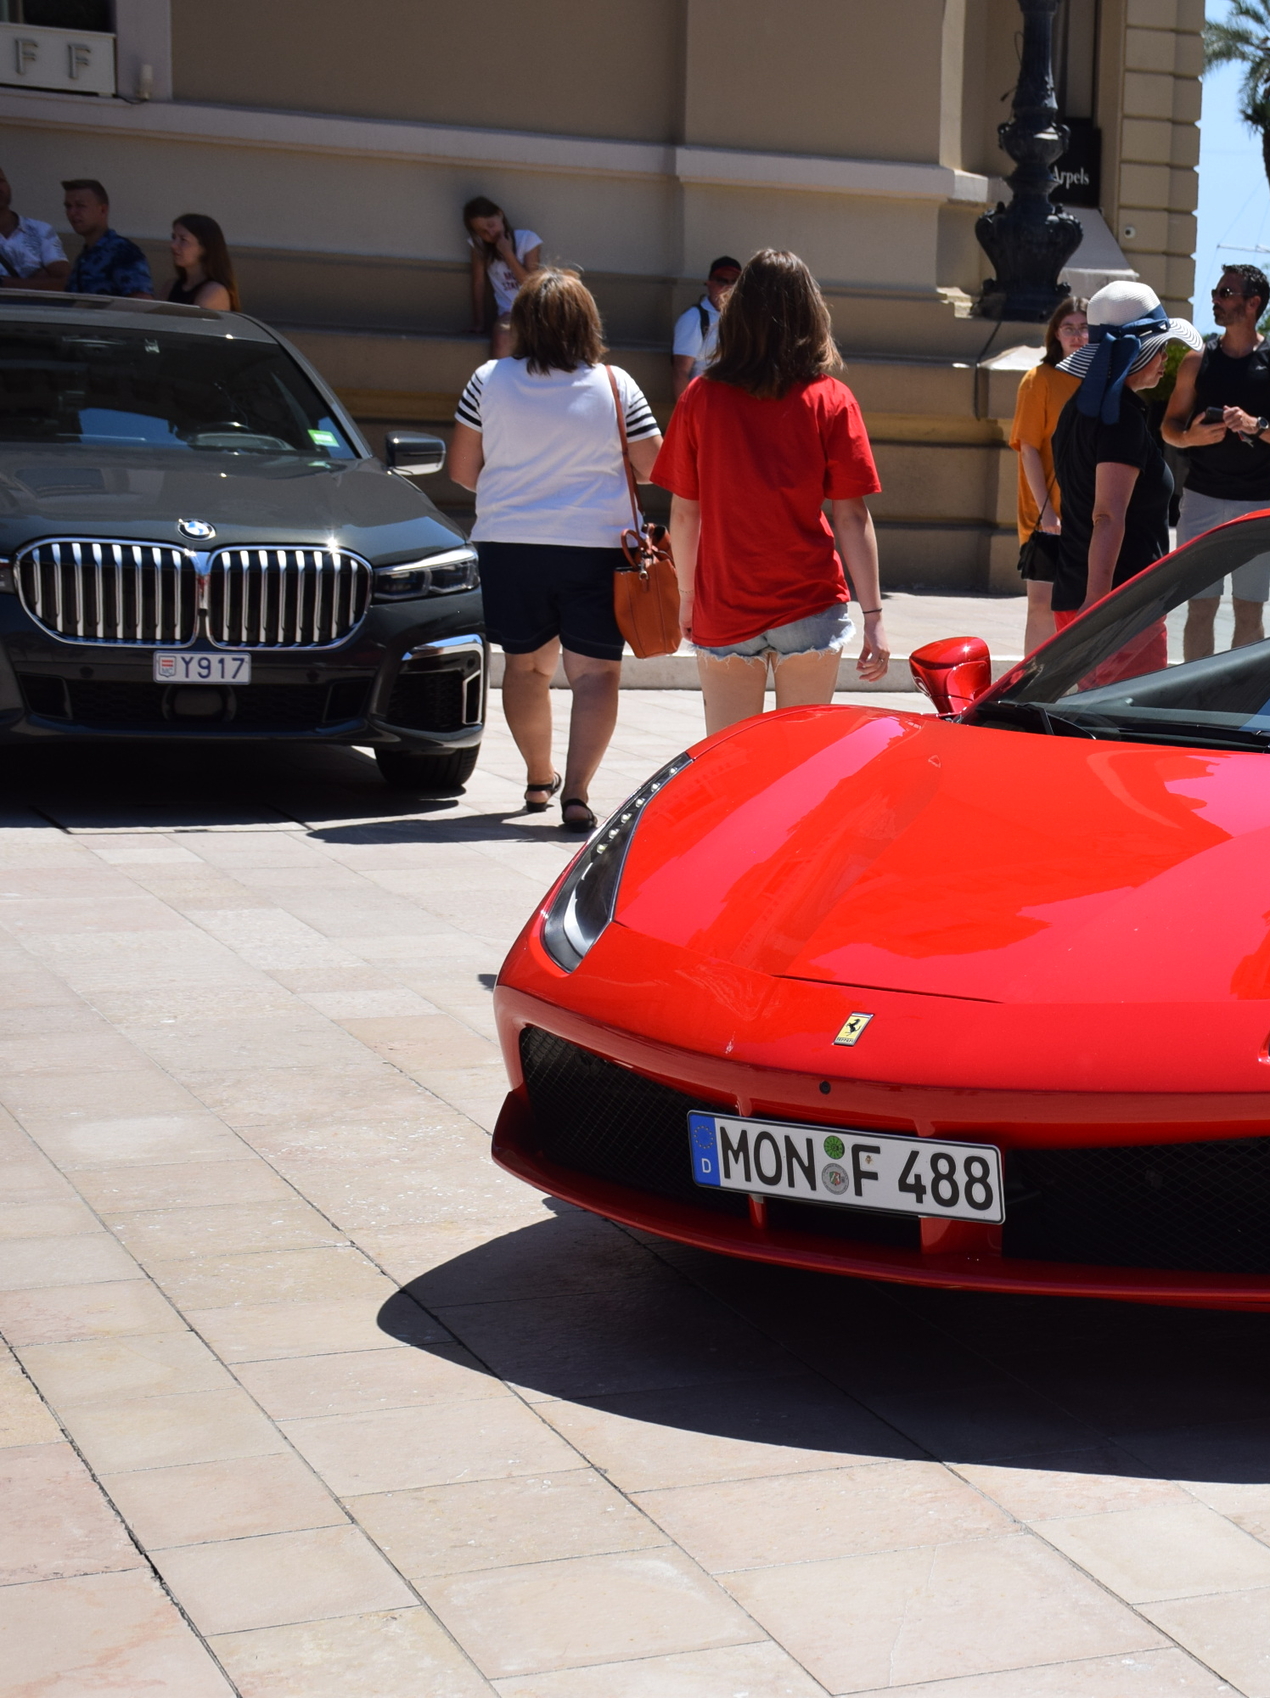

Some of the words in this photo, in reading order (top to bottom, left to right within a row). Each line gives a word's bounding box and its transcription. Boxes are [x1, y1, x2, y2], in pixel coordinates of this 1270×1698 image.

[1052, 165, 1090, 189] Arpels
[180, 656, 245, 679] Y917
[701, 1158, 712, 1174] D
[719, 1126, 817, 1191] MON
[851, 1143, 881, 1197] F
[898, 1150, 994, 1211] 488
